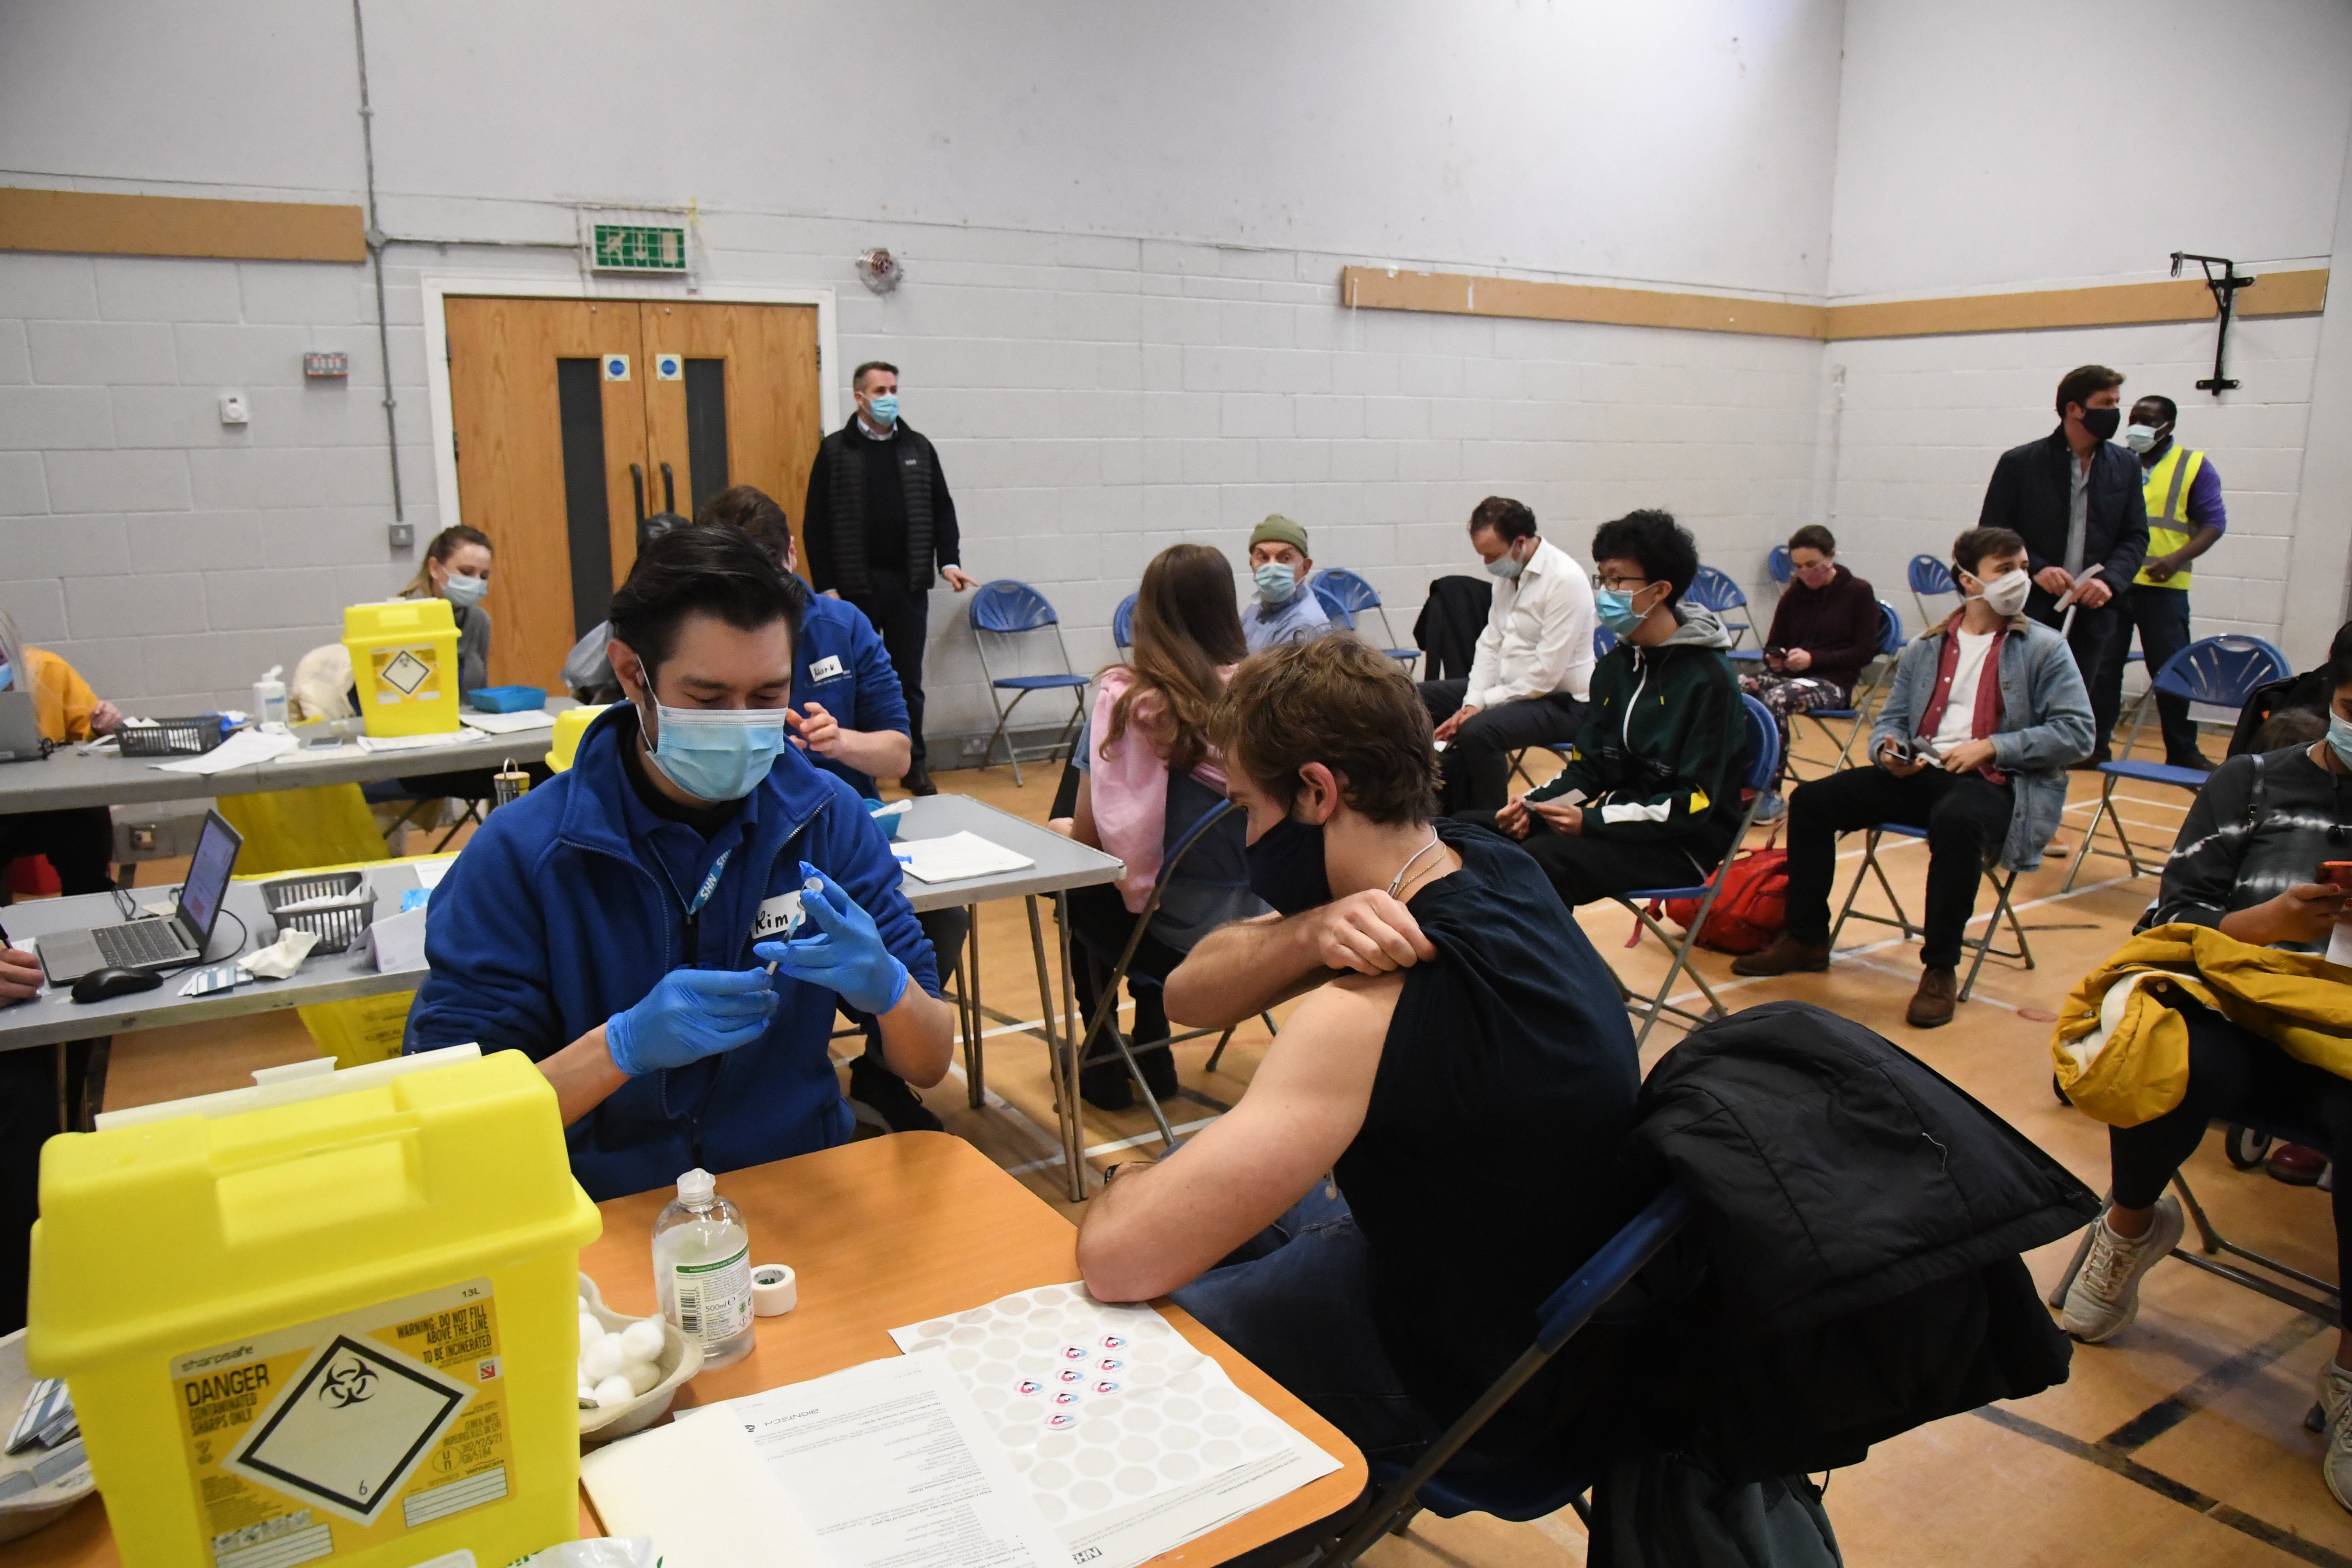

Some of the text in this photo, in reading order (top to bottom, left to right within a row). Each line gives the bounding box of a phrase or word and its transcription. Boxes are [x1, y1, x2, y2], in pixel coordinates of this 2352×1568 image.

[700, 873, 717, 901] NHS
[755, 910, 789, 934] Kim
[462, 1288, 481, 1298] 13L
[705, 1301, 727, 1312] 500ml
[439, 1314, 450, 1327] DO
[452, 1309, 467, 1324] NOT
[470, 1305, 487, 1320] FILL
[427, 1317, 489, 1345] ABOVE THE LINE
[423, 1350, 433, 1364] TO
[434, 1347, 444, 1361] BE
[446, 1334, 492, 1358] INCINERATED
[182, 1345, 253, 1372] sharpsafe
[185, 1364, 270, 1407] DANGER
[188, 1393, 257, 1421] CONTAMINATED
[191, 1414, 228, 1436] SHARPS
[1282, 1456, 1303, 1465] COVID-19
[957, 1471, 982, 1480] Marketing
[1260, 1464, 1284, 1475] Vaccination
[358, 1480, 368, 1496] 6
[924, 1478, 956, 1489] Authorisation
[1216, 1487, 1234, 1495] Evaluation
[1233, 1480, 1251, 1489] Service
[953, 1493, 979, 1503] Comirnaty
